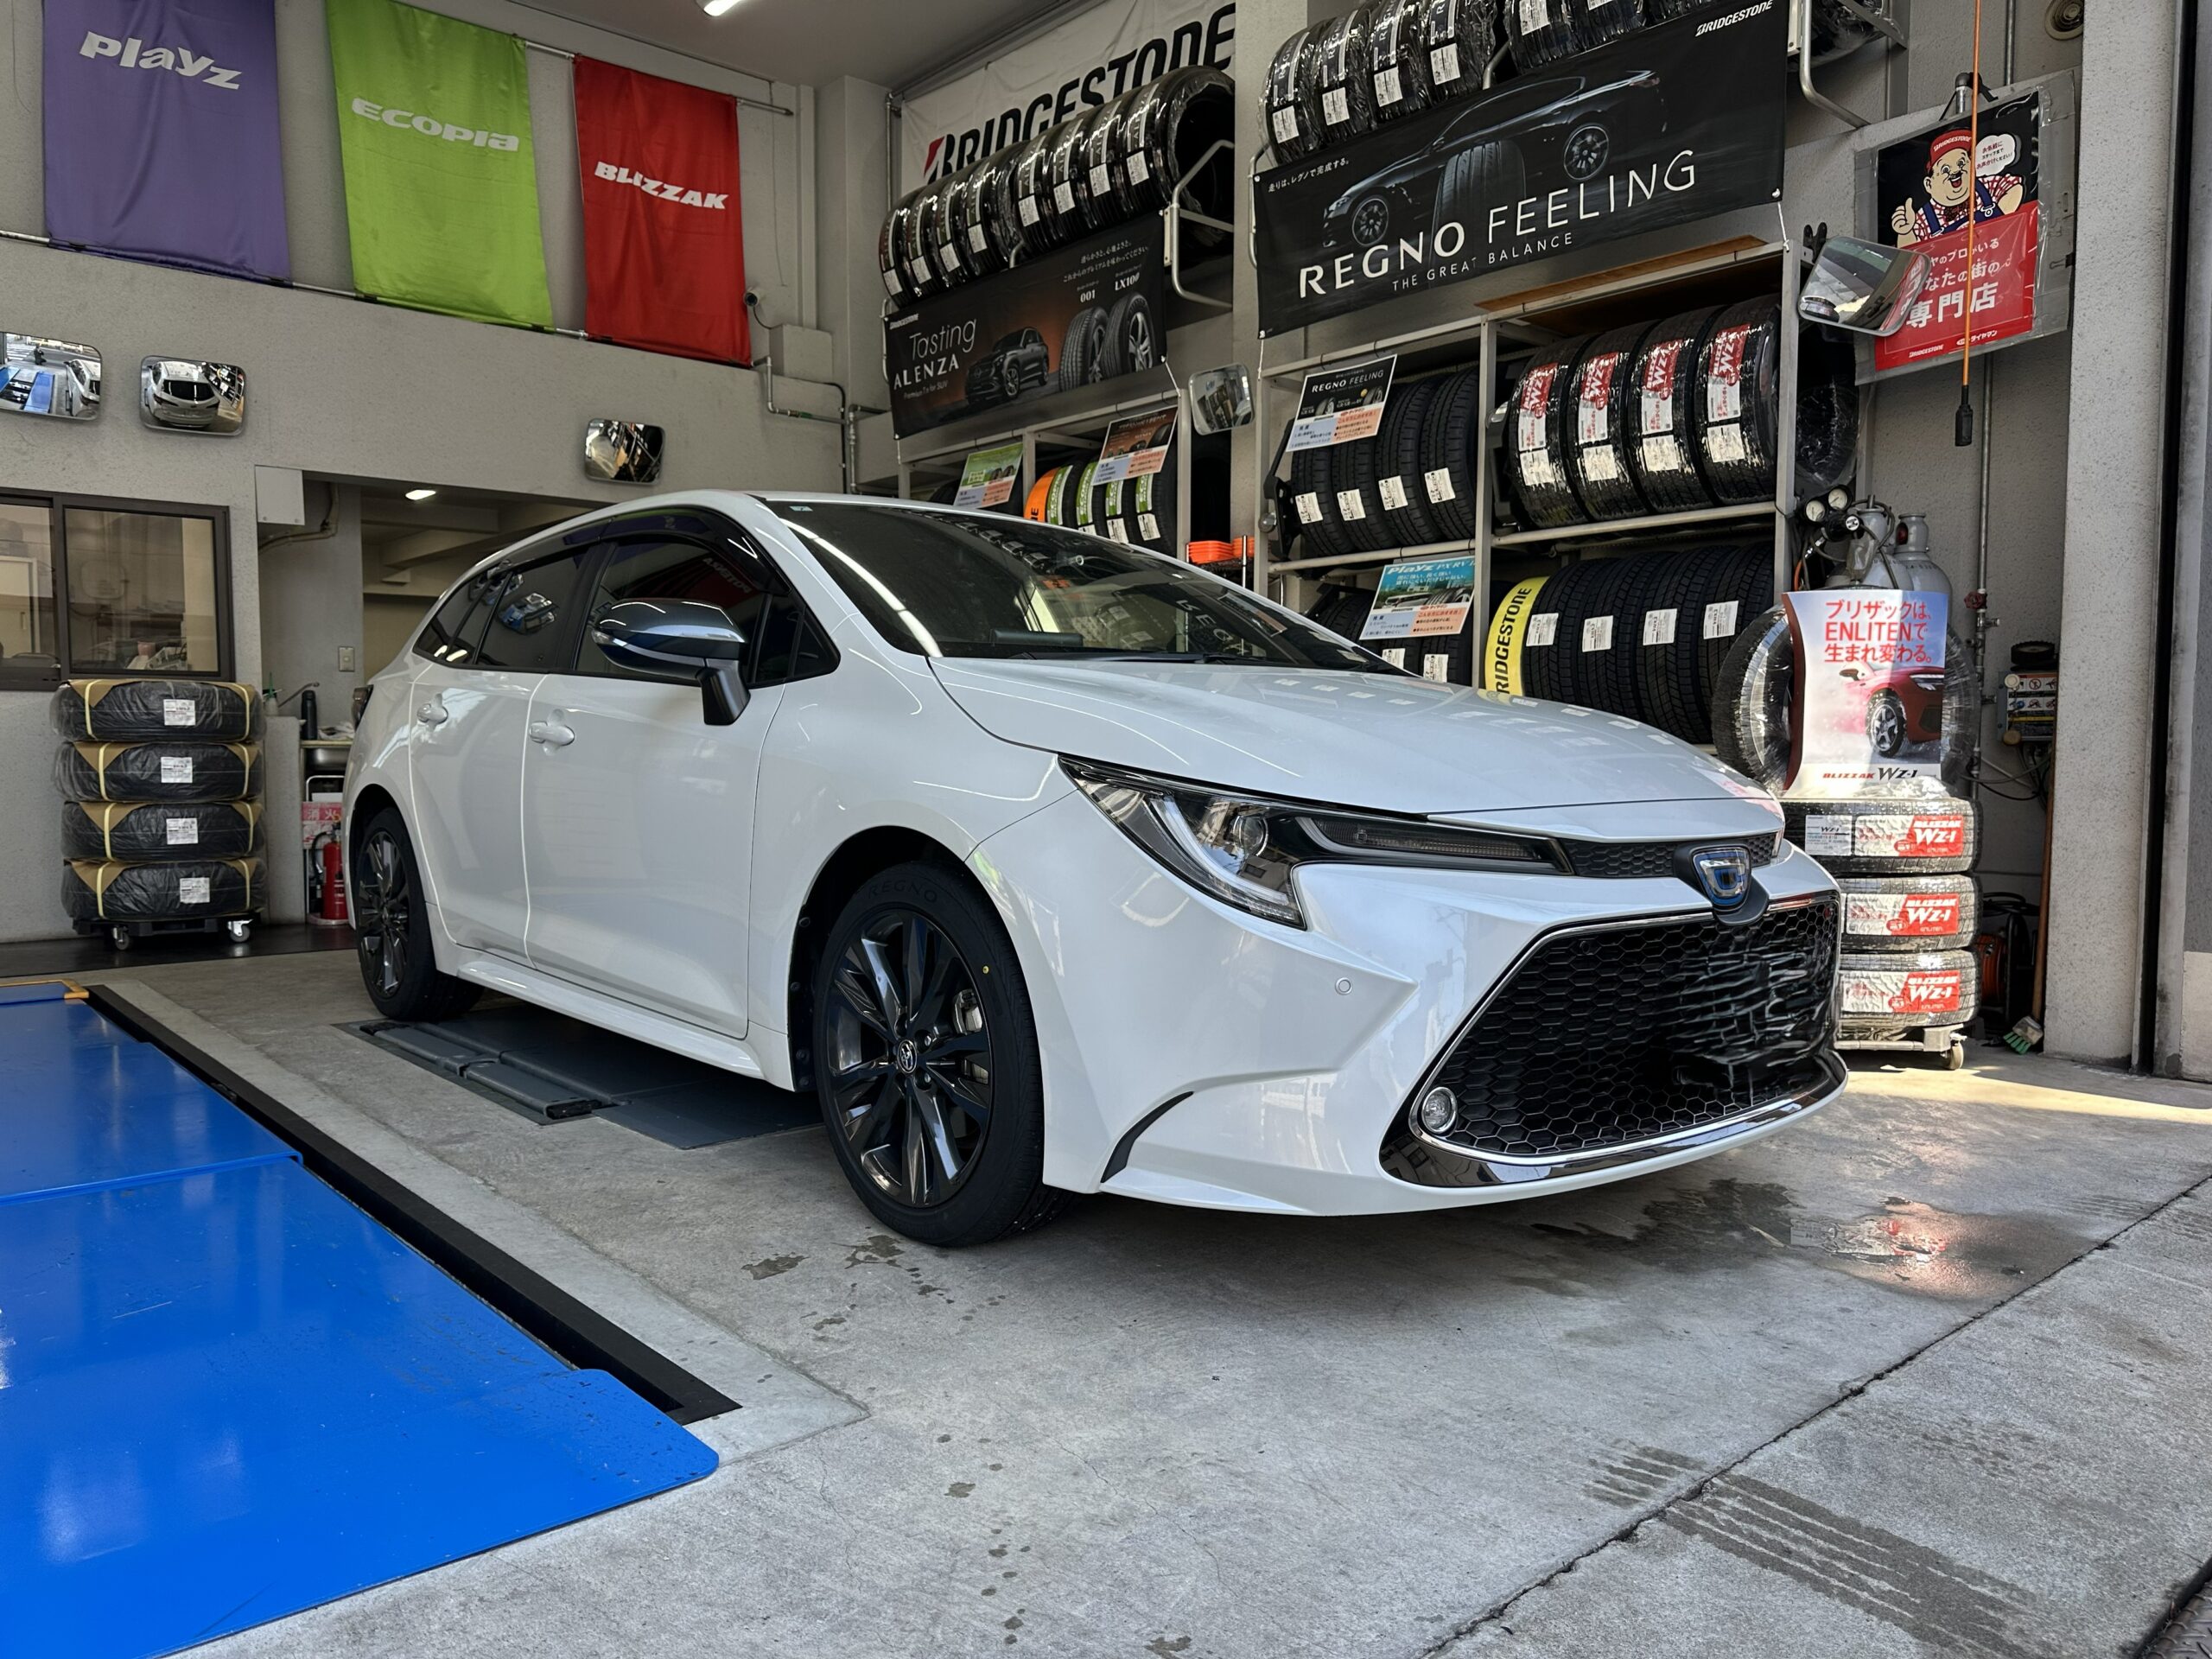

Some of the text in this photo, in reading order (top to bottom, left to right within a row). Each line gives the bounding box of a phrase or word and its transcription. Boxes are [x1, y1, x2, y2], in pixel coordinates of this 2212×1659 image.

[1695, 0, 1772, 37] BRIDGESTONE
[924, 2, 1236, 183] BRIDGESTONE
[1933, 136, 1972, 152] BRIDGESTONE
[594, 161, 729, 209] BLIZZAK
[1268, 157, 1349, 192] 走りは、レグノで完成する。
[1300, 149, 1696, 298] REGNO FEELING
[1391, 232, 1573, 291] THE GREAT BALANCE
[1080, 289, 1096, 302] 001
[1906, 282, 1999, 328] 専門店
[909, 319, 976, 360] Tasting
[1909, 344, 1944, 358] BRIDGESTONE
[893, 353, 959, 390] ALENZA
[1312, 379, 1346, 393] REGNO
[1349, 369, 1384, 385] FEELING
[1387, 563, 1434, 575] Playz
[1825, 600, 1931, 628] ブリザックは、
[1495, 588, 1532, 694] RIDGESTONE
[1824, 644, 1932, 664] 生まれ変わる。
[1878, 767, 1917, 780] WZ-1
[1915, 829, 1956, 845] WZ-1
[868, 879, 938, 904] REGNO
[1907, 907, 1951, 925] WZ-1
[1908, 986, 1953, 1001] WZ-1
